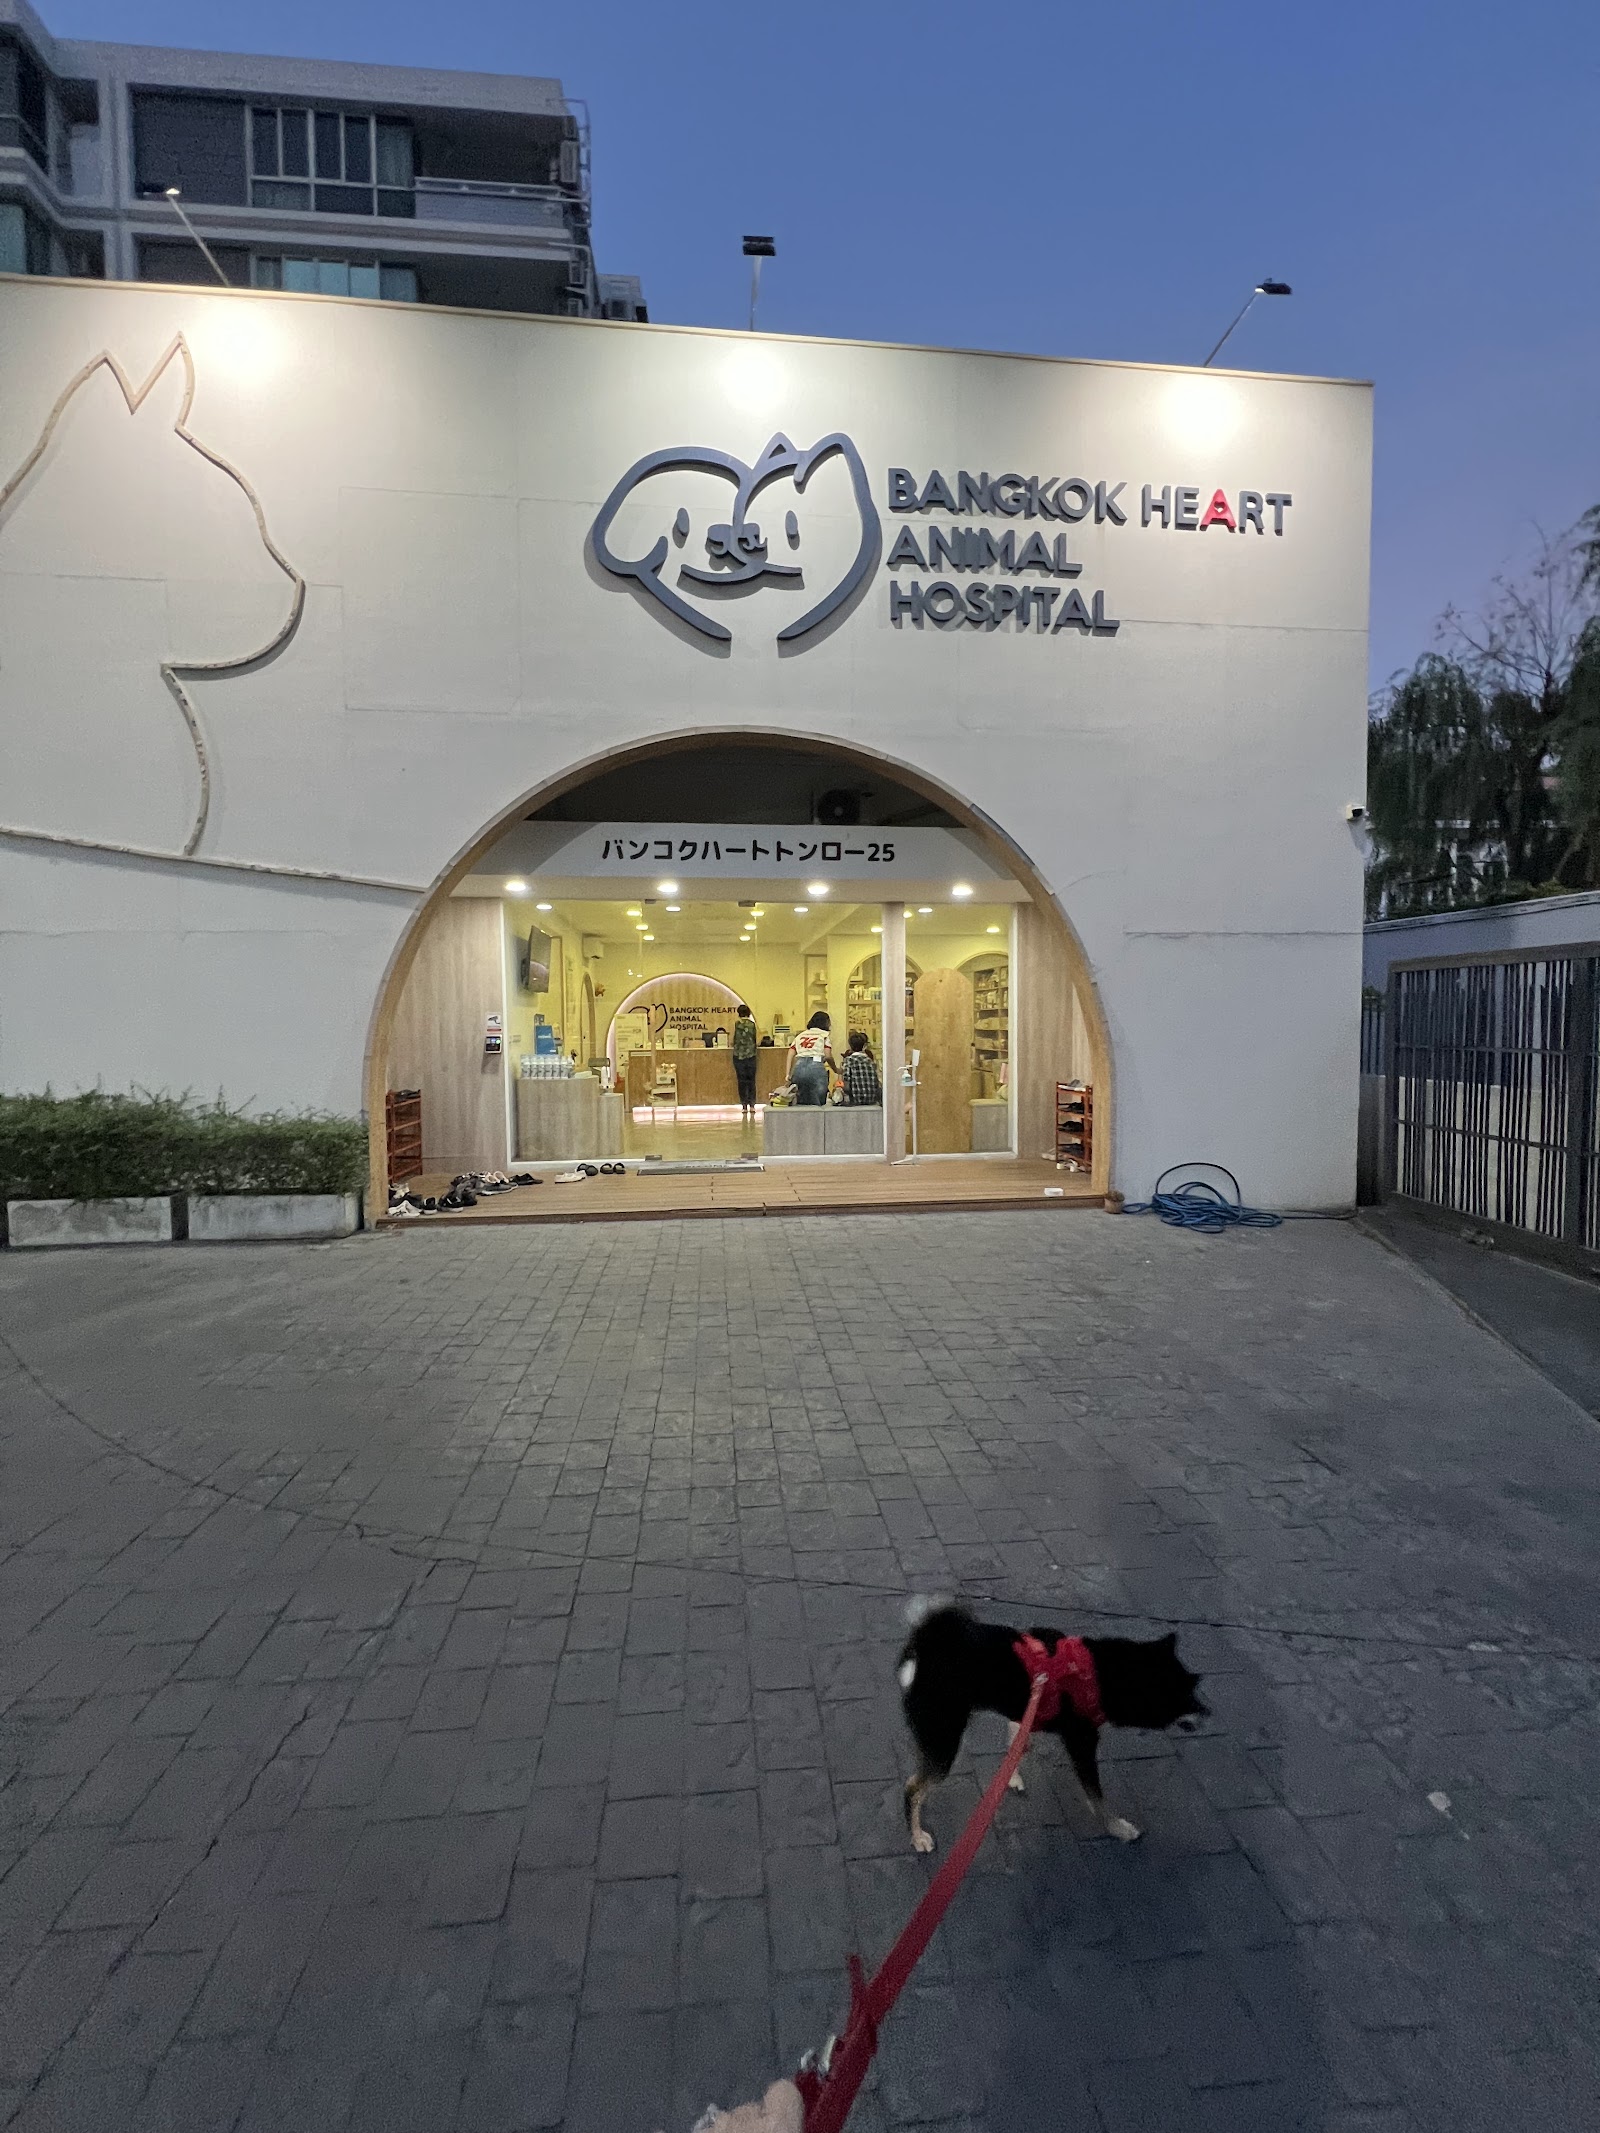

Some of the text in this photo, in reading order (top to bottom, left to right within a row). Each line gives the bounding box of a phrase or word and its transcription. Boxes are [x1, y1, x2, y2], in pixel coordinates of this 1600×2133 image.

[887, 467, 1292, 536] BANGKOK HEART
[886, 525, 1082, 579] ANIMAL
[889, 580, 1120, 637] HOSPITAL
[601, 839, 896, 862] バンコクハートトンロー25
[669, 1023, 708, 1031] HOSPITAL
